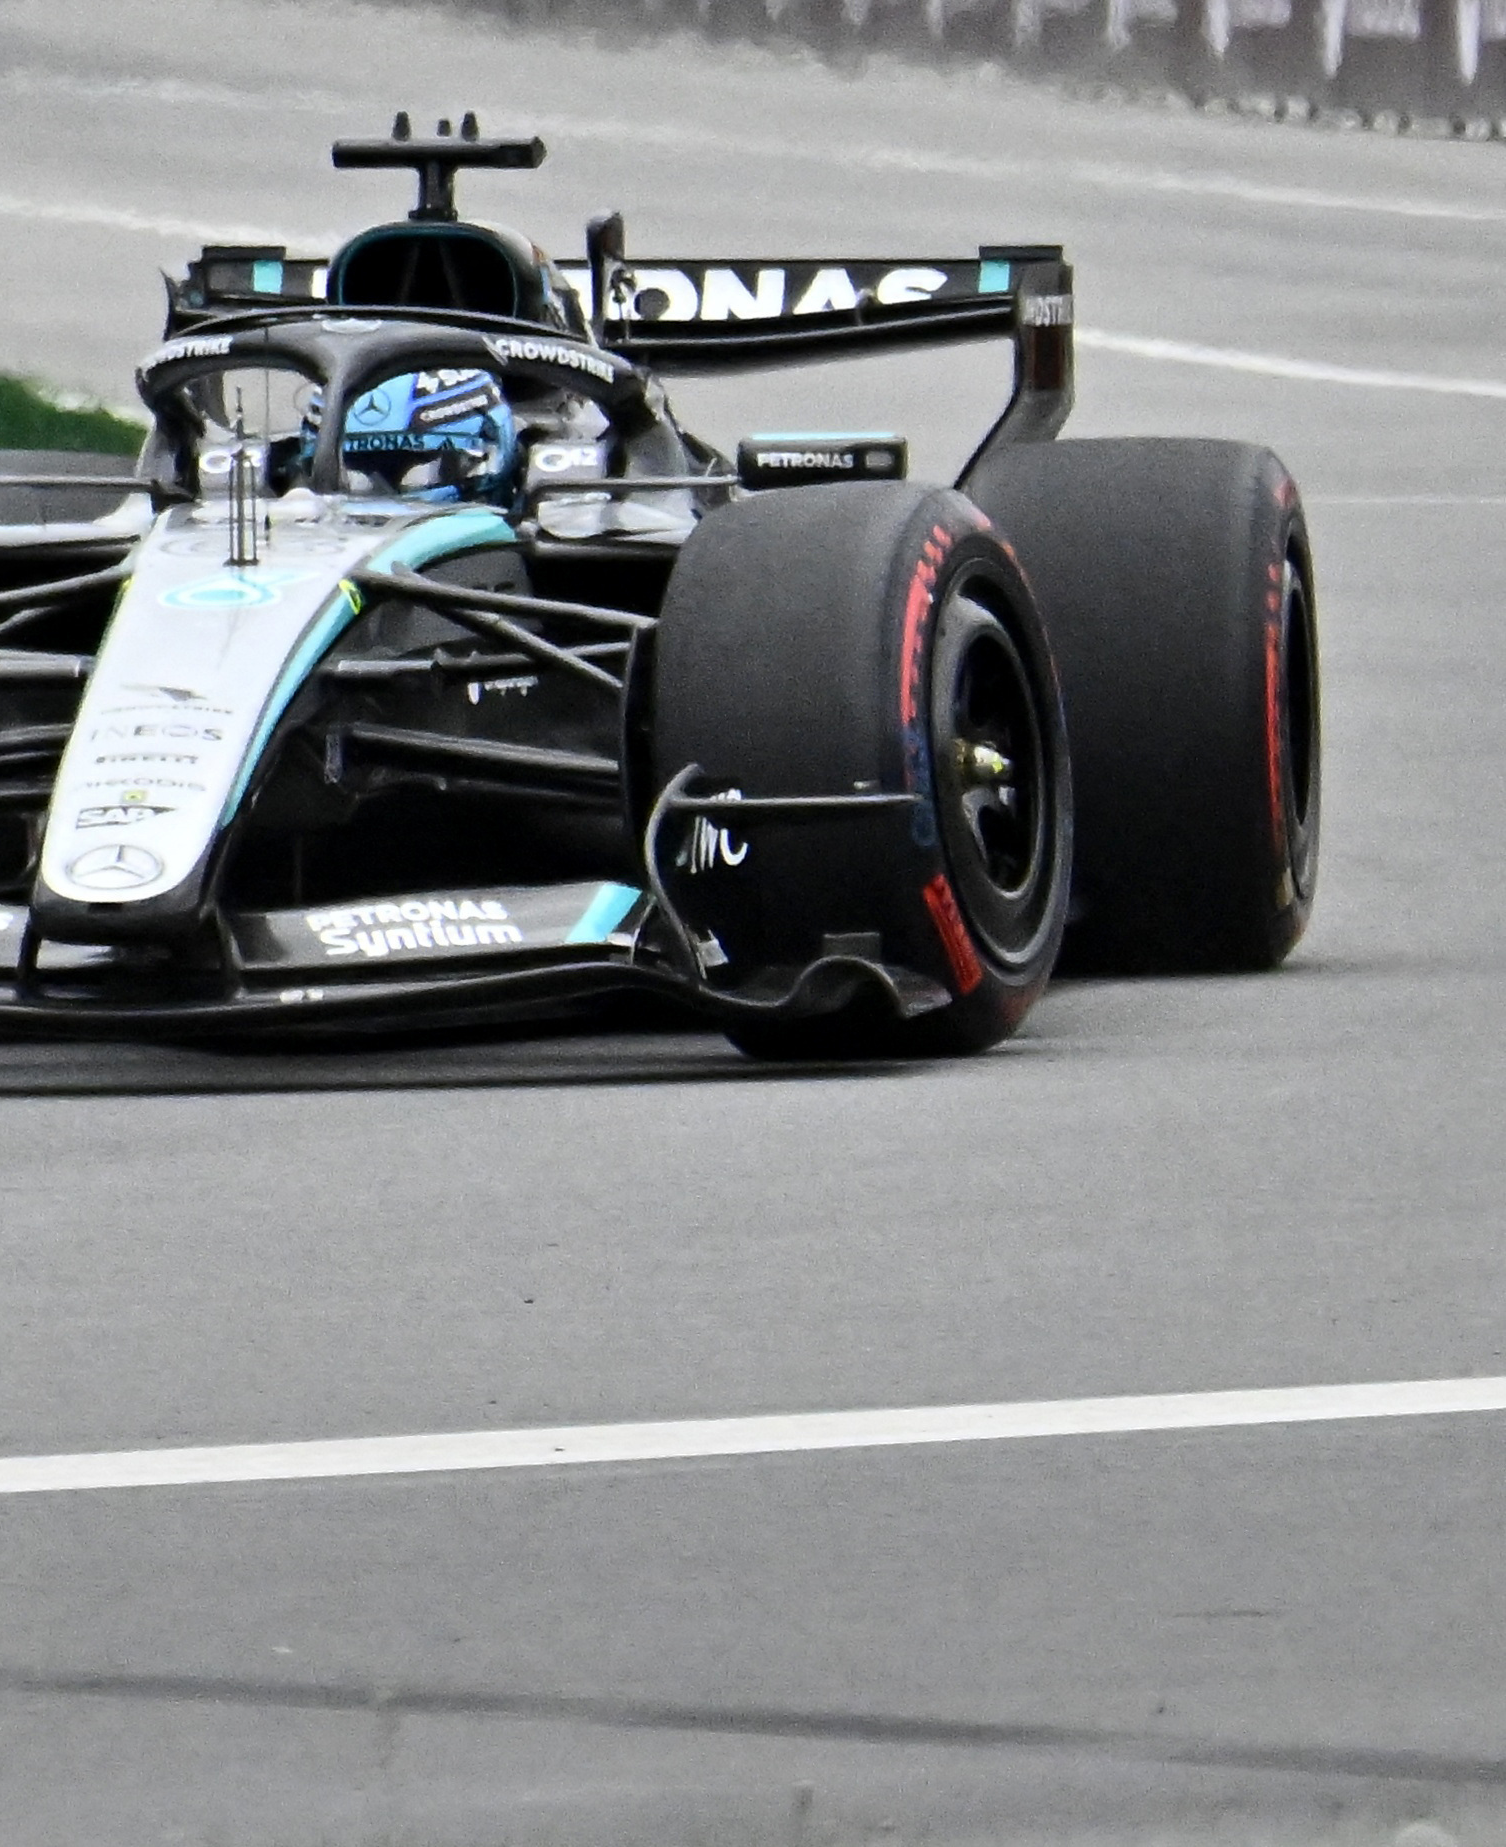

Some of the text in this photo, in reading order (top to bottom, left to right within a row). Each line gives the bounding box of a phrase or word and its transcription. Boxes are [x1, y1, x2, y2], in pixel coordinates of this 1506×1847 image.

[494, 338, 615, 385] CROWDSTRIKE
[348, 433, 426, 451] TRONAS
[755, 450, 855, 469] PETRONAS
[305, 899, 509, 933] PETRONAS
[319, 920, 524, 957] Syntium
